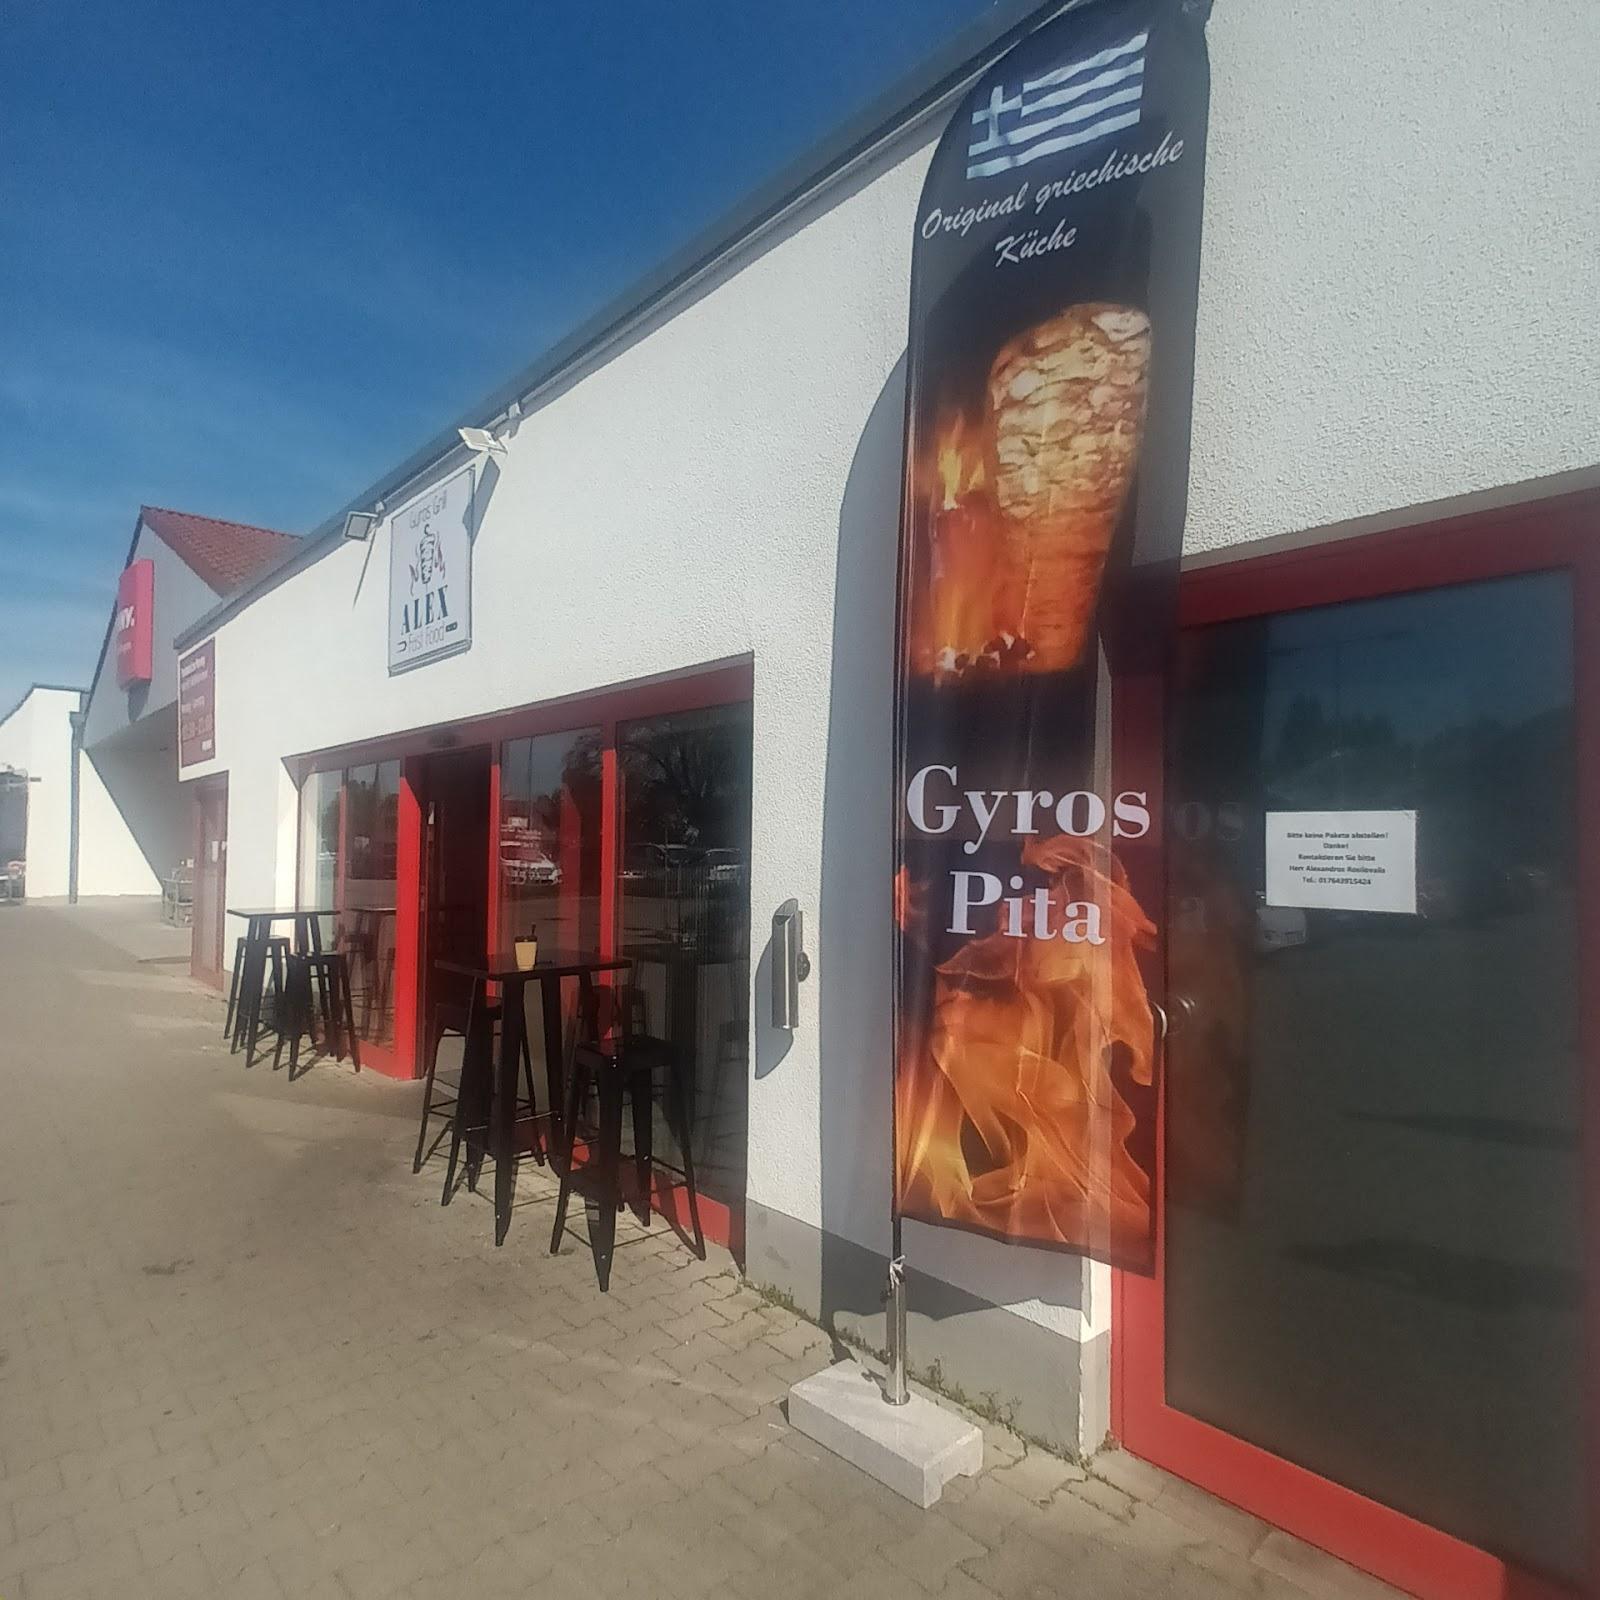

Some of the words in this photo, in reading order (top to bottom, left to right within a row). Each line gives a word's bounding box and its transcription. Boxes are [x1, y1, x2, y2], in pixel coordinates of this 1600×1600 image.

[921, 182, 1030, 240] Original
[1035, 130, 1184, 214] griechische
[995, 218, 1078, 267] Küche
[400, 584, 448, 636] ALEX
[906, 764, 1150, 855] Gyros
[1298, 853, 1344, 861] Kontaktieren
[1357, 854, 1376, 862] bitte
[946, 870, 1106, 946] Pita
